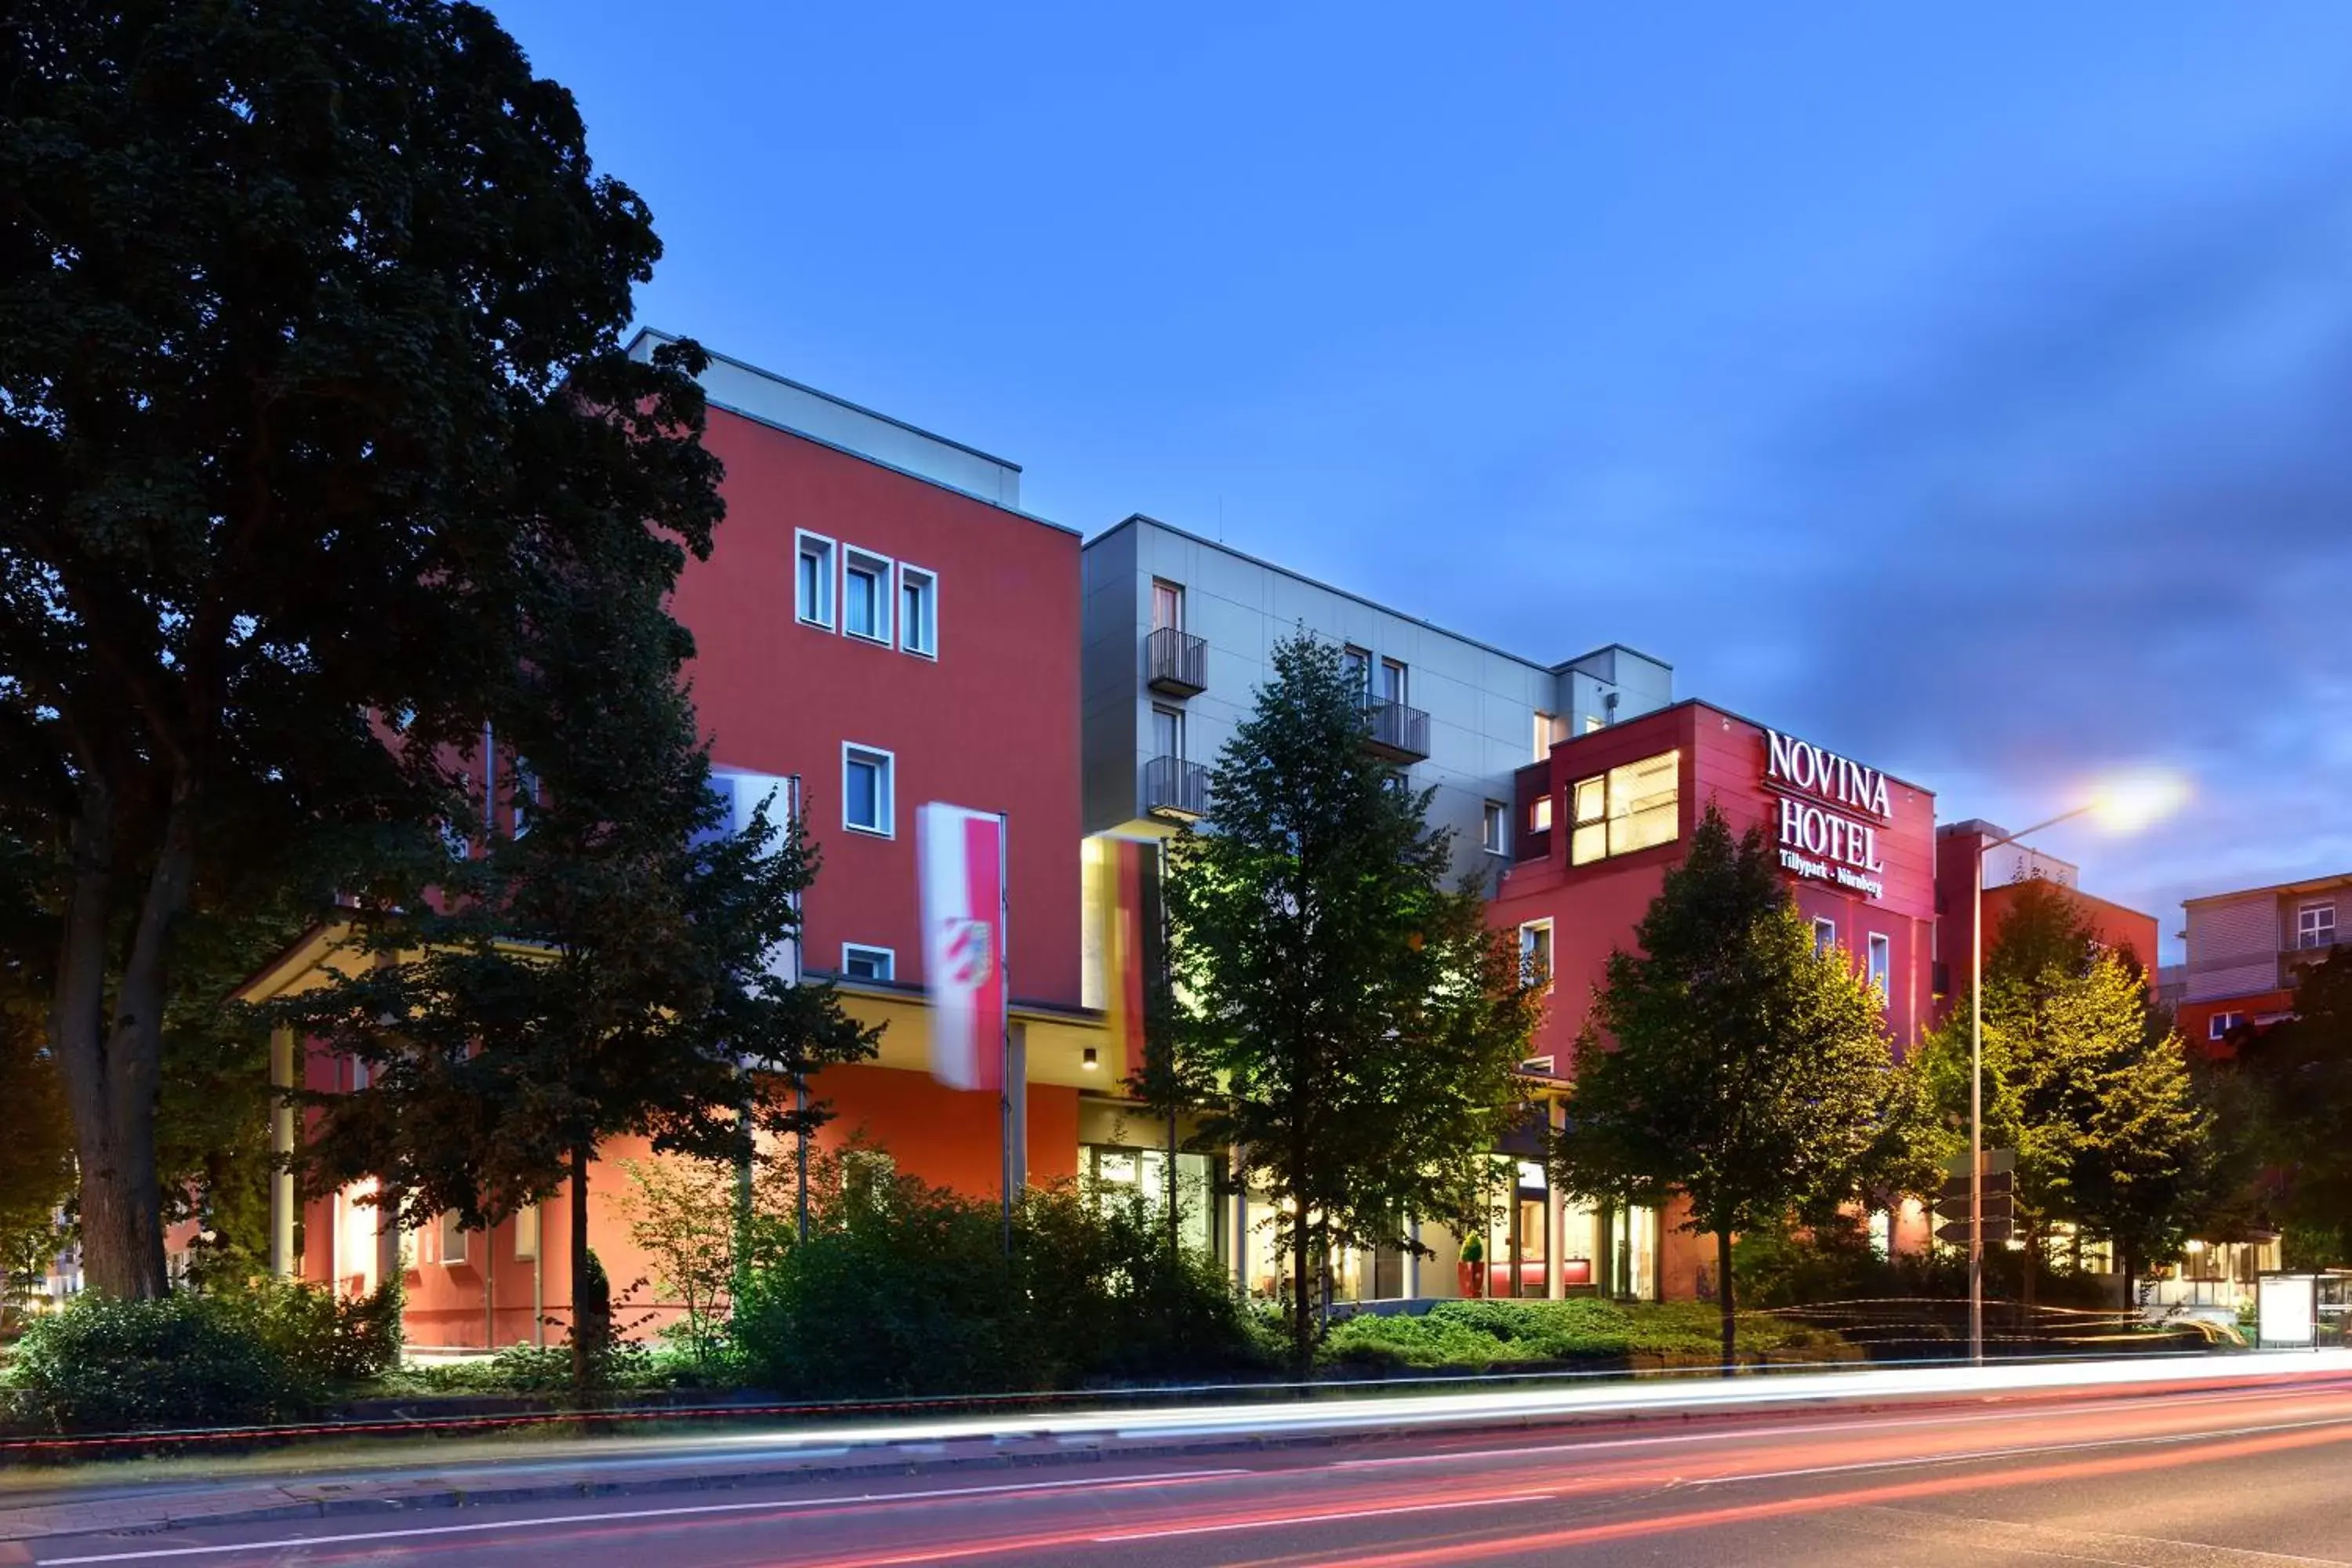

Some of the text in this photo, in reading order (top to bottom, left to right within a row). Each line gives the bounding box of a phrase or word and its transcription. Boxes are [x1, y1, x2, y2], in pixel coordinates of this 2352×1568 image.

[1767, 729, 1892, 818] NOVINA
[1779, 848, 1828, 879] Tillypark
[1837, 866, 1882, 898] Nürnberg
[1780, 798, 1882, 873] HOTEL
